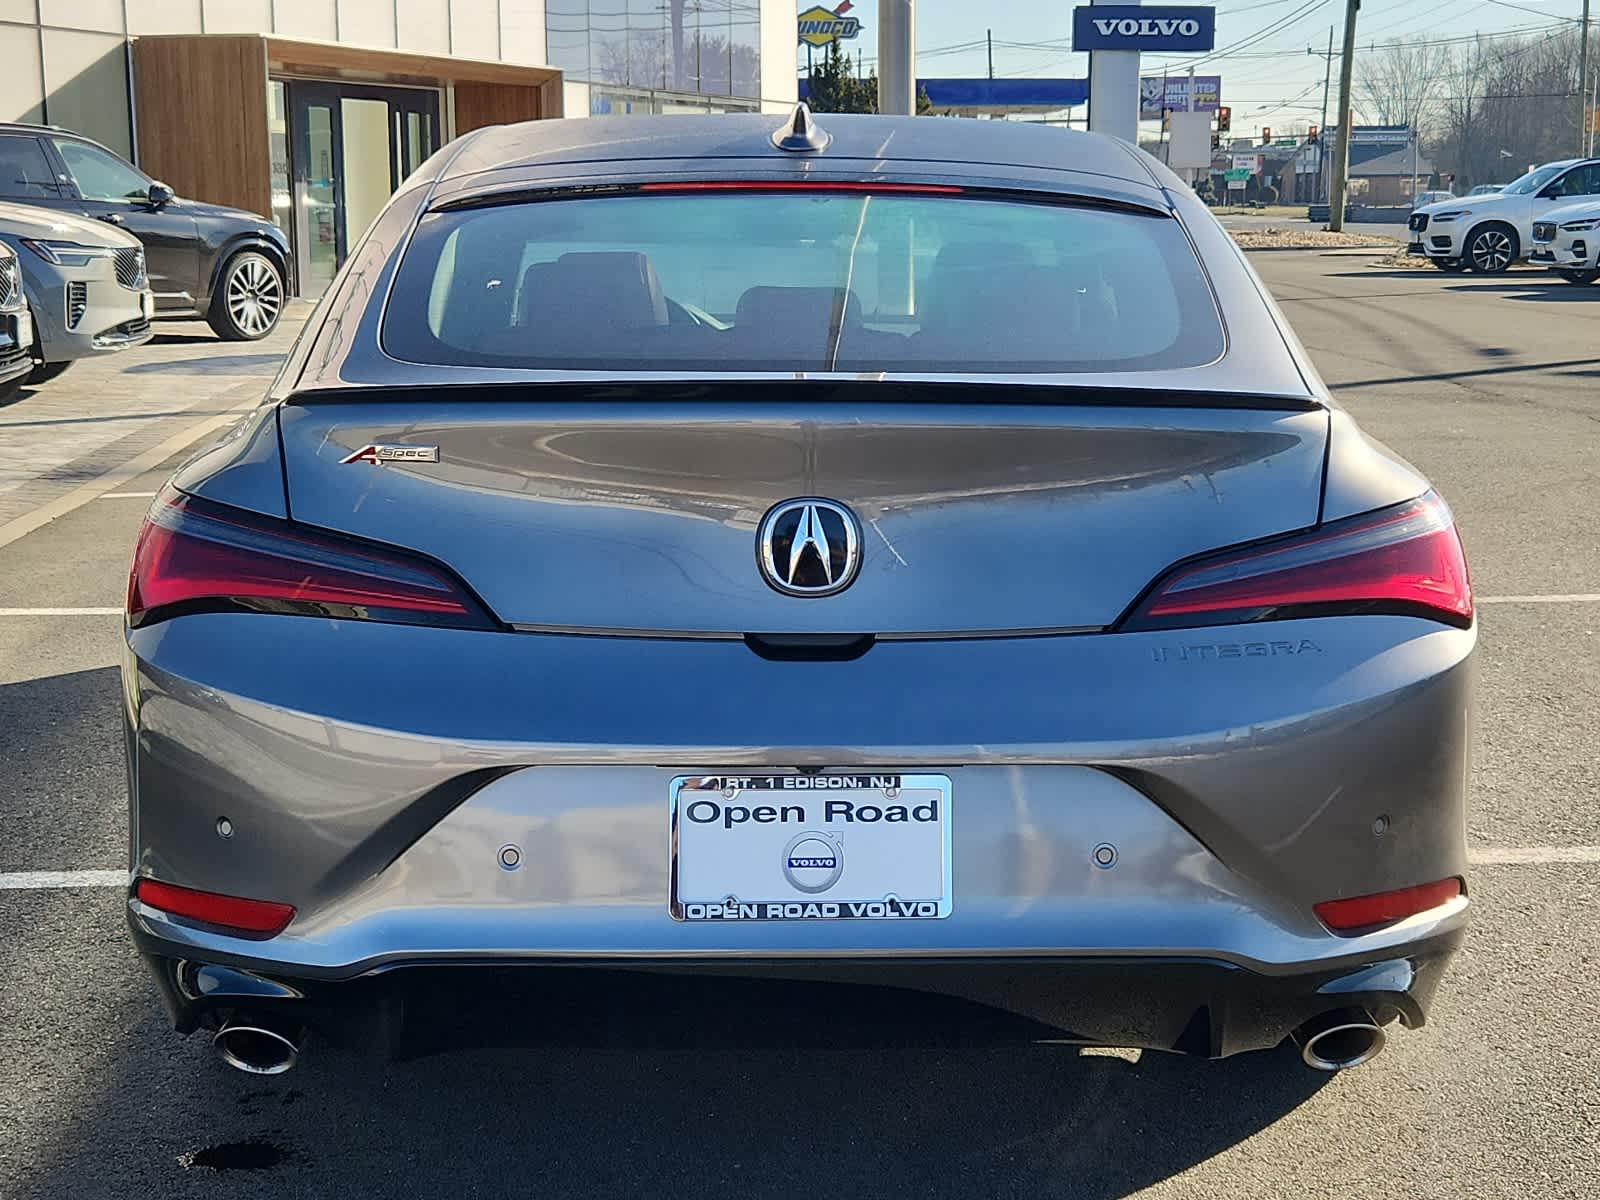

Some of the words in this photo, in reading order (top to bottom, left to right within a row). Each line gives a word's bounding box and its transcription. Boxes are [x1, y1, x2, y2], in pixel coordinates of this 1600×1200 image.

[798, 21, 855, 34] UNOCO
[1092, 19, 1200, 36] VOLVO
[1166, 83, 1216, 94] UNLIITED
[1151, 640, 1322, 663] INTEGRA
[766, 777, 775, 789] 1
[783, 777, 862, 789] EDISON,
[869, 777, 896, 789] NJ
[686, 800, 805, 829] Open
[824, 800, 938, 823] Road
[791, 858, 834, 868] VOLVO
[687, 904, 758, 919] OPEN
[767, 903, 840, 918] ROAD
[850, 903, 937, 917] VOLVO
